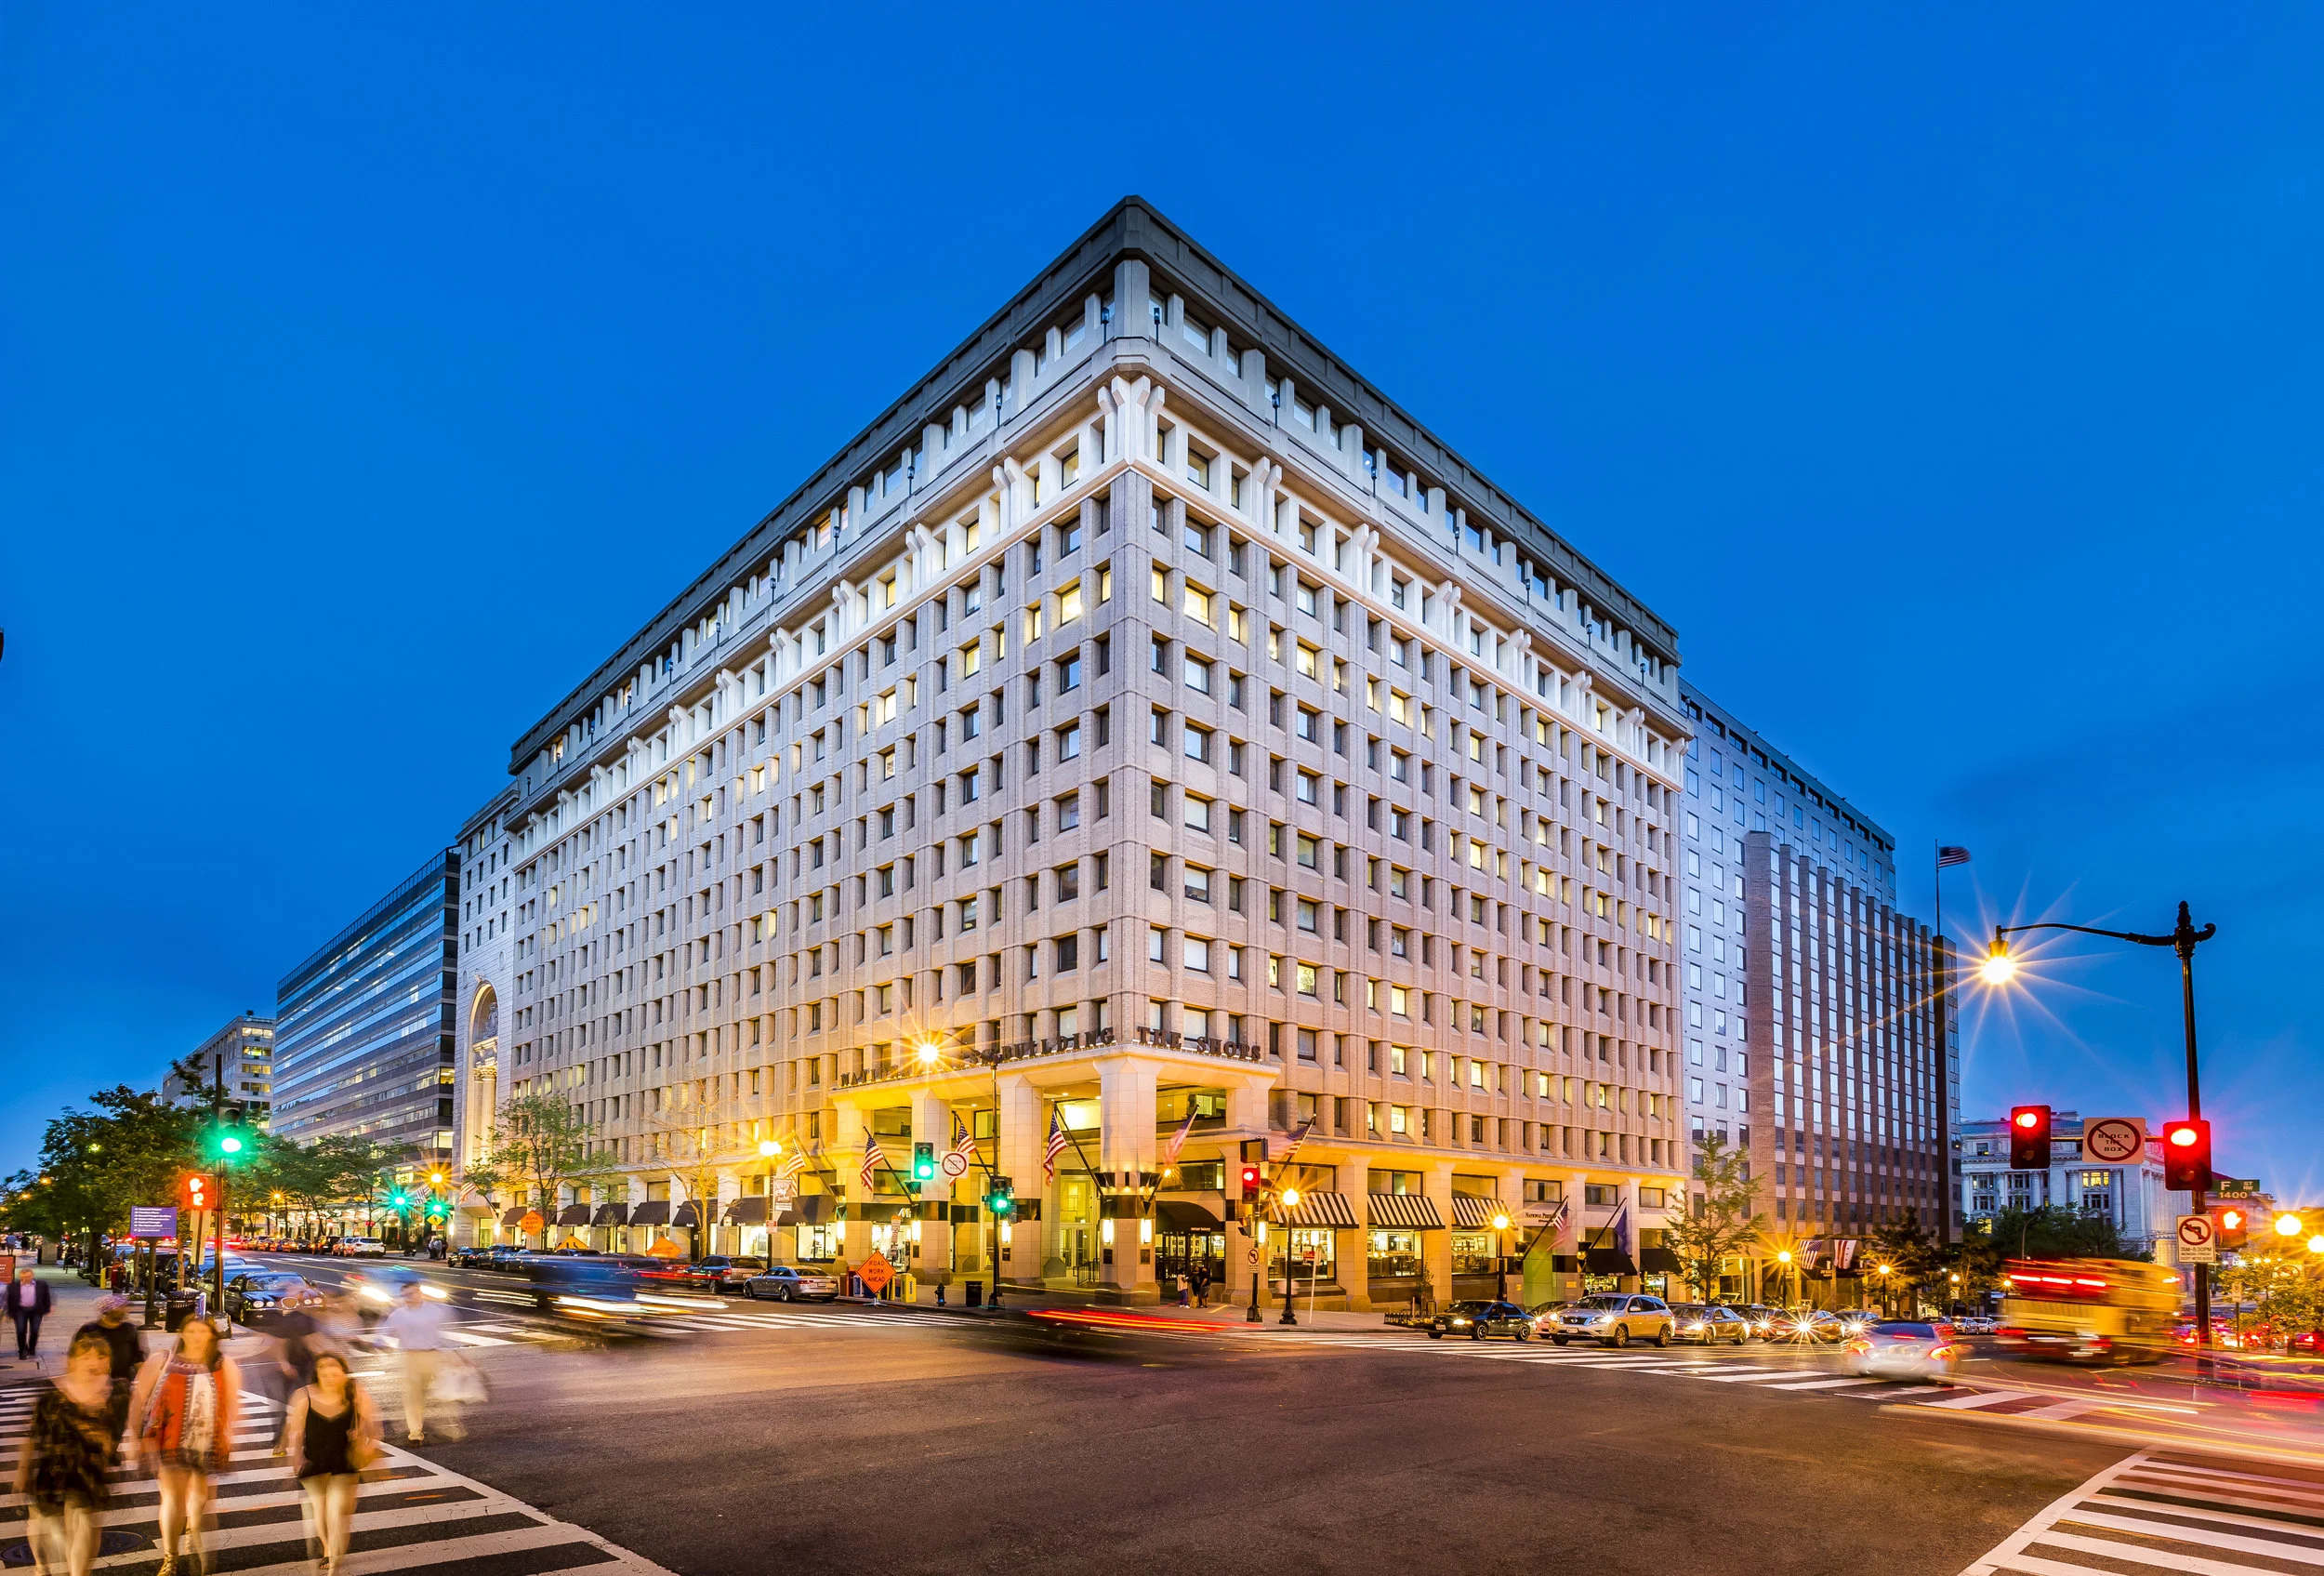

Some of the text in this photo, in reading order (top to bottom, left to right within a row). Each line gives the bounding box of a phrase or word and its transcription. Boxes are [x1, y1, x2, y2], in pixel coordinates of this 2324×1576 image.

[1001, 1026, 1116, 1060] BUILDING
[1137, 1026, 1261, 1061] THE SHOPS
[2220, 1181, 2231, 1190] F
